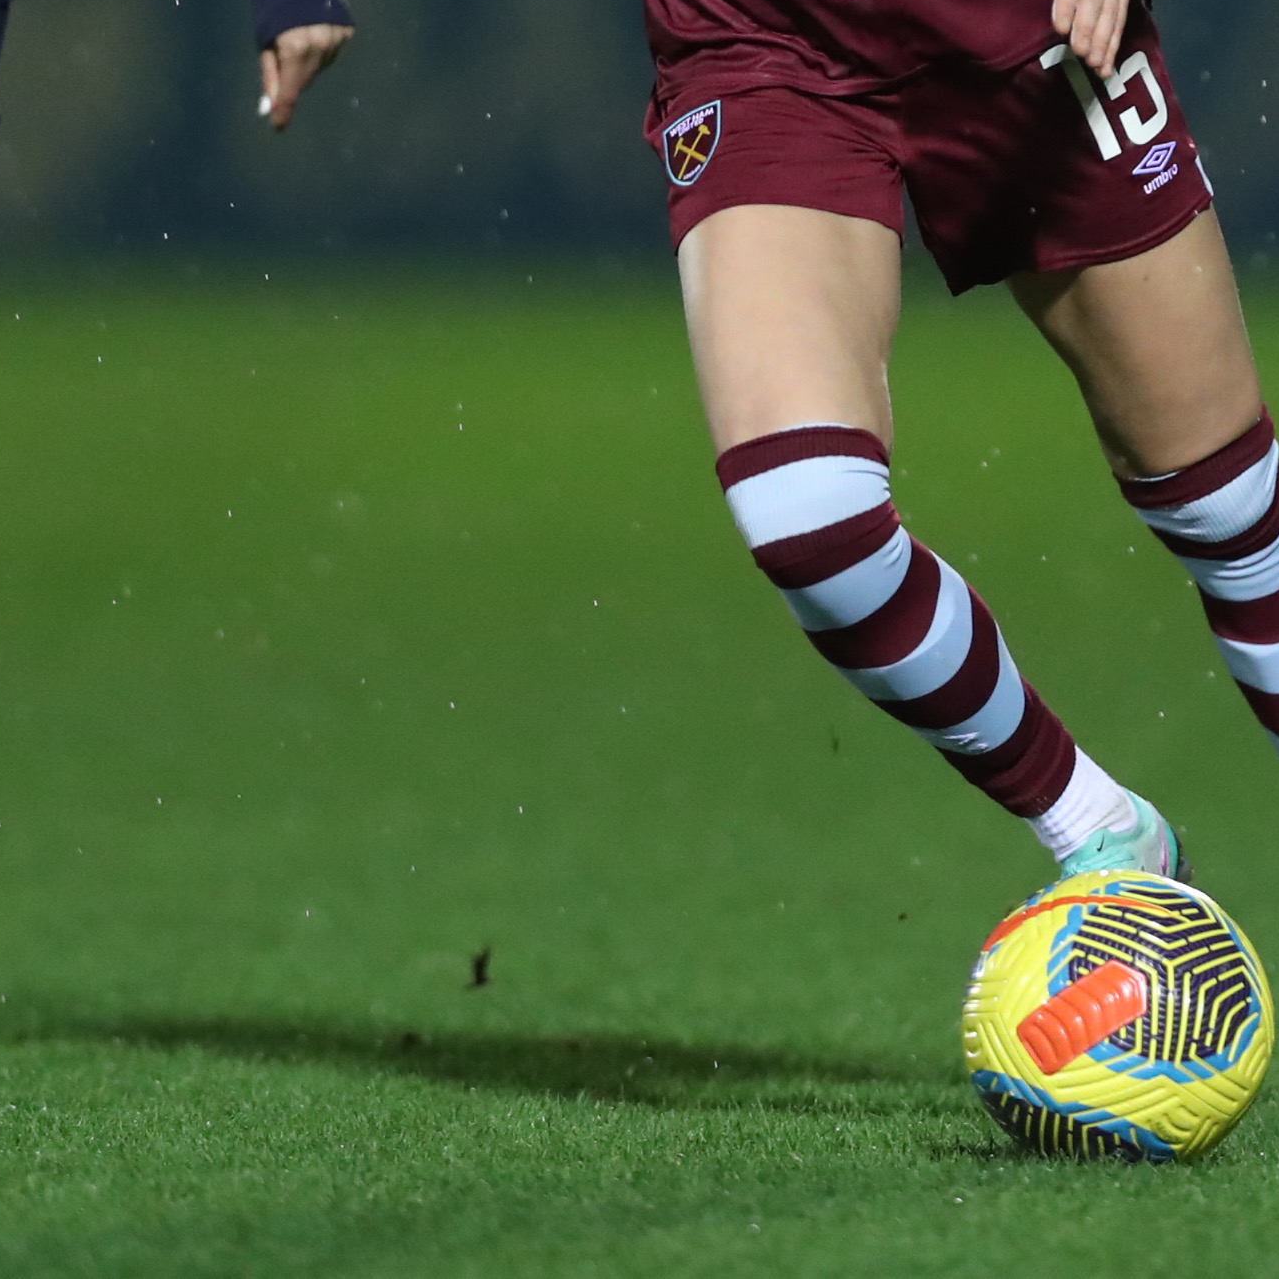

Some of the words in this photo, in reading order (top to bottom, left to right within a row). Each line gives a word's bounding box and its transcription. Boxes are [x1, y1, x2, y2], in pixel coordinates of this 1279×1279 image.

[690, 106, 714, 125] HAM
[1039, 44, 1168, 161] 15
[1143, 163, 1178, 194] umbro
